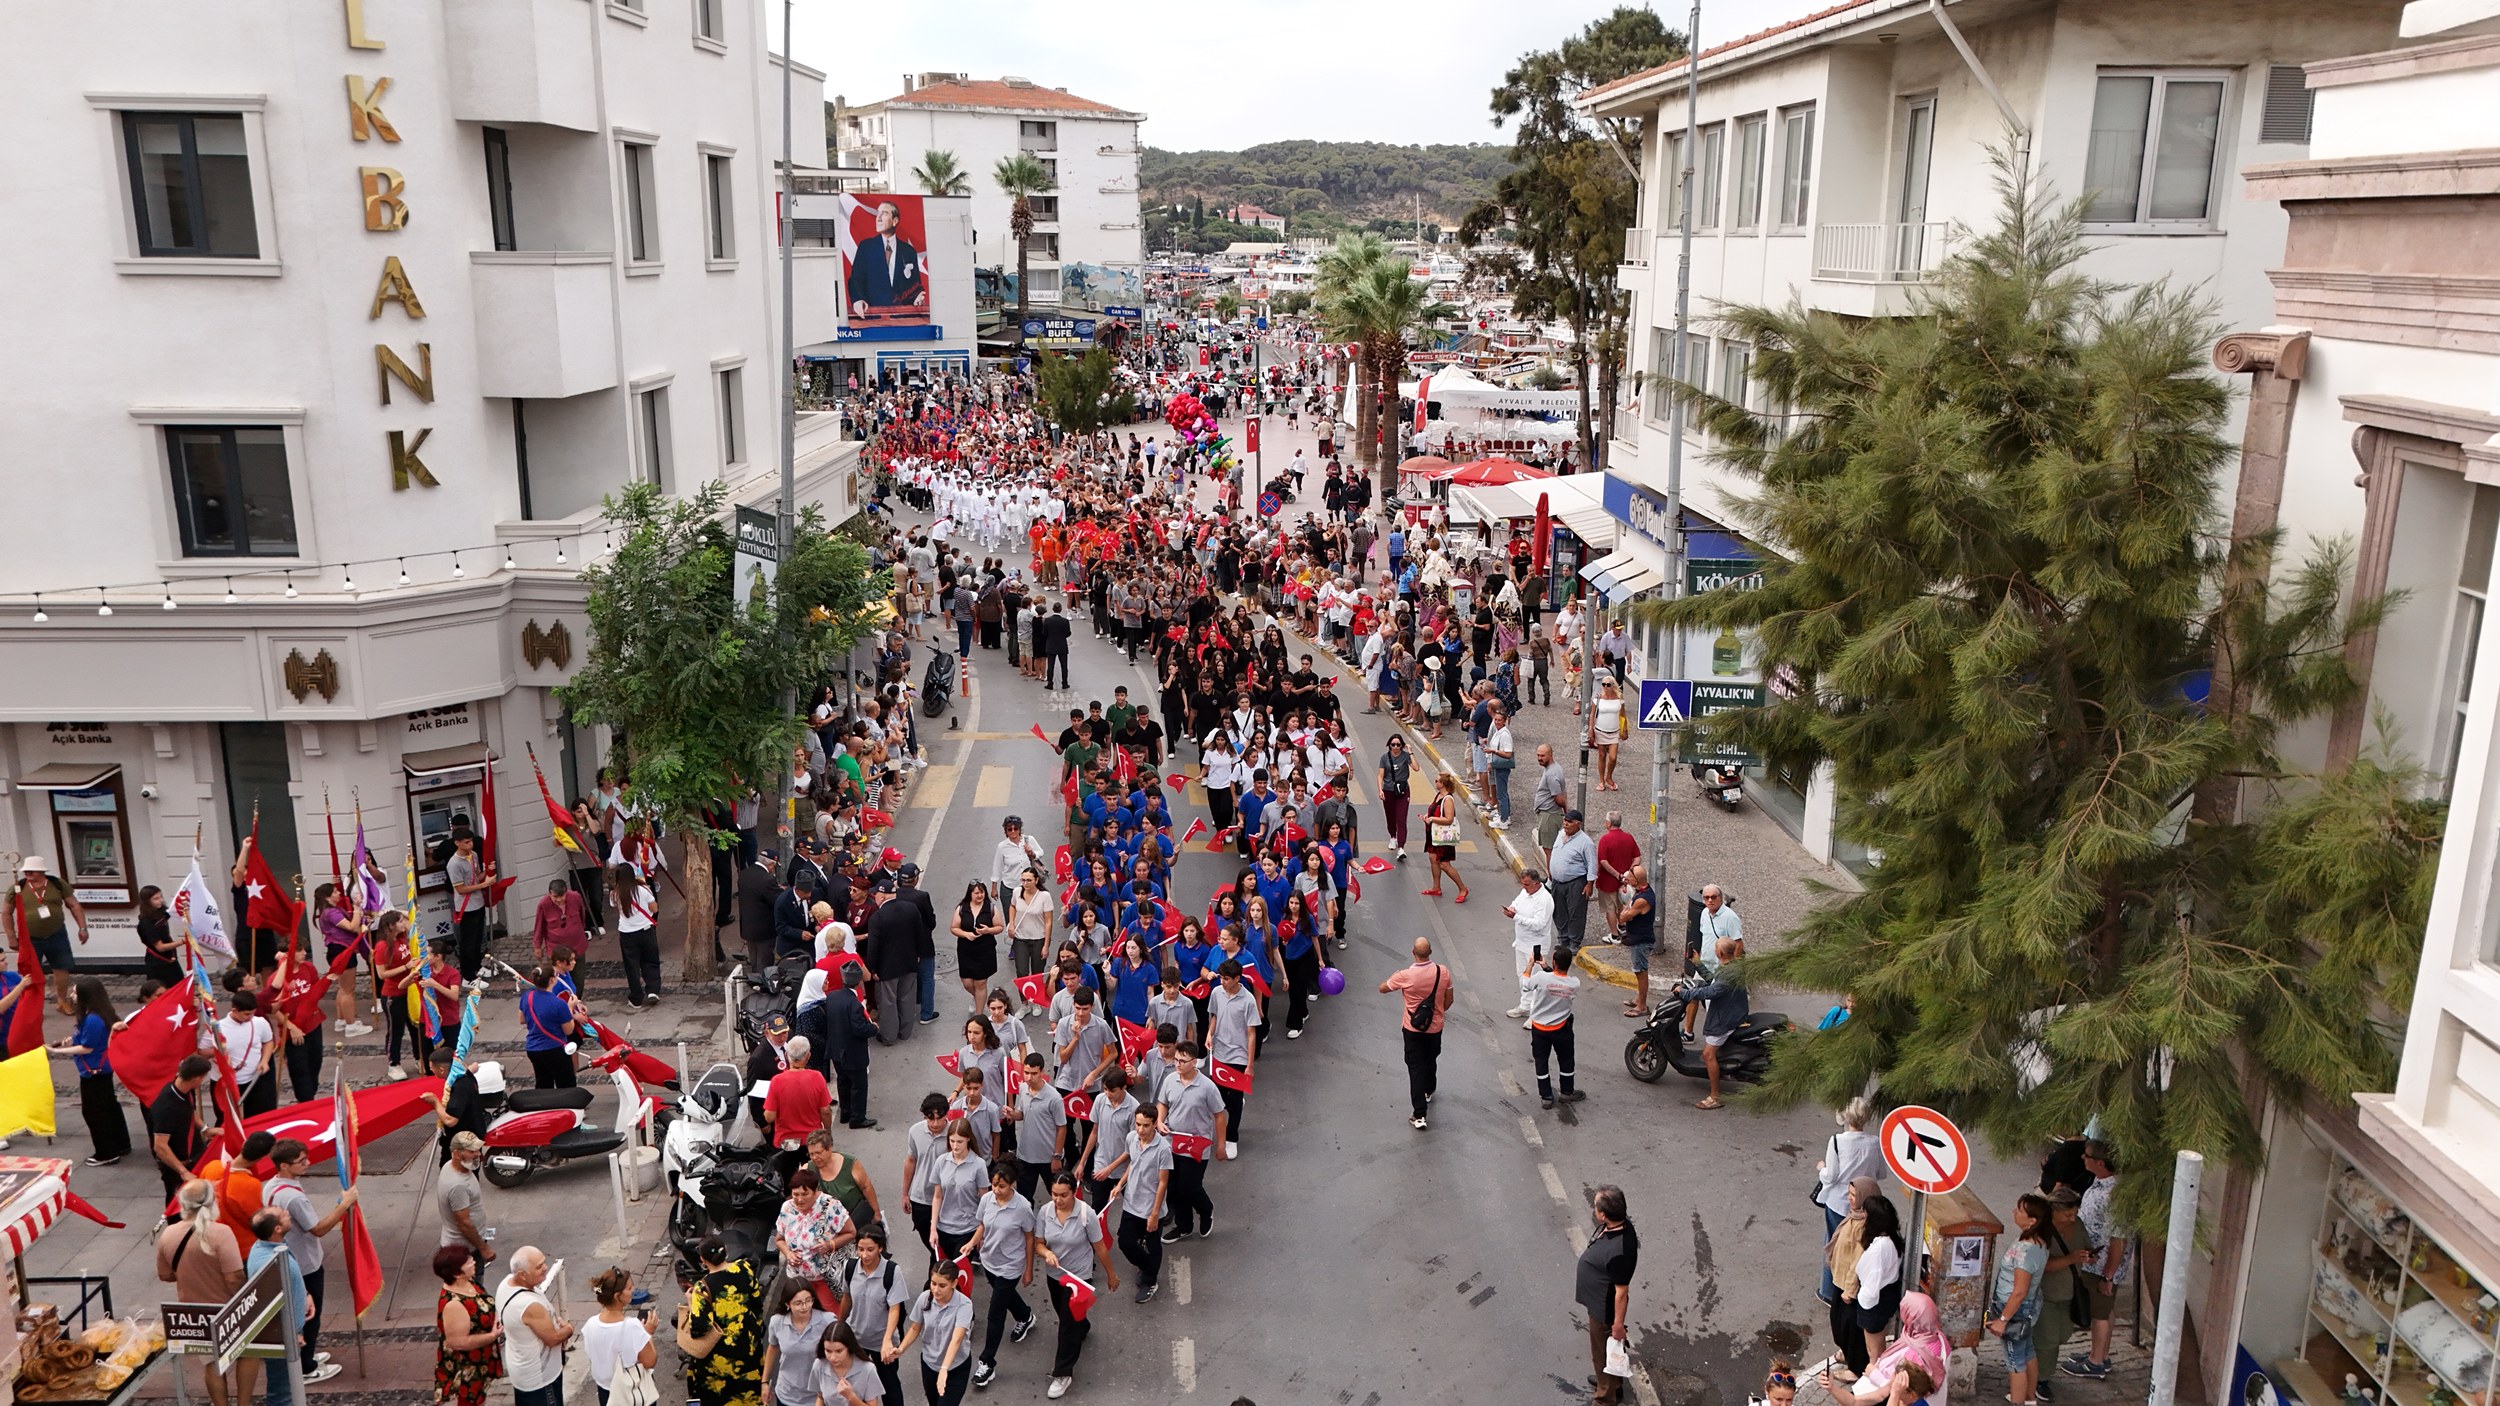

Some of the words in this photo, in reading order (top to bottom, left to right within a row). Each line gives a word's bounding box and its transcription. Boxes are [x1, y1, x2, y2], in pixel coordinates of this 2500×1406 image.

[1047, 329, 1072, 337] BÜFE
[1695, 686, 1755, 700] AYVALIK'IN
[408, 720, 433, 733] Açık
[435, 716, 469, 728] Banka
[52, 734, 76, 746] Açık
[78, 734, 112, 744] Banka
[218, 1288, 258, 1342] ATATÜRK
[169, 1328, 205, 1337] CADDESİ
[219, 1326, 241, 1354] BULVARI
